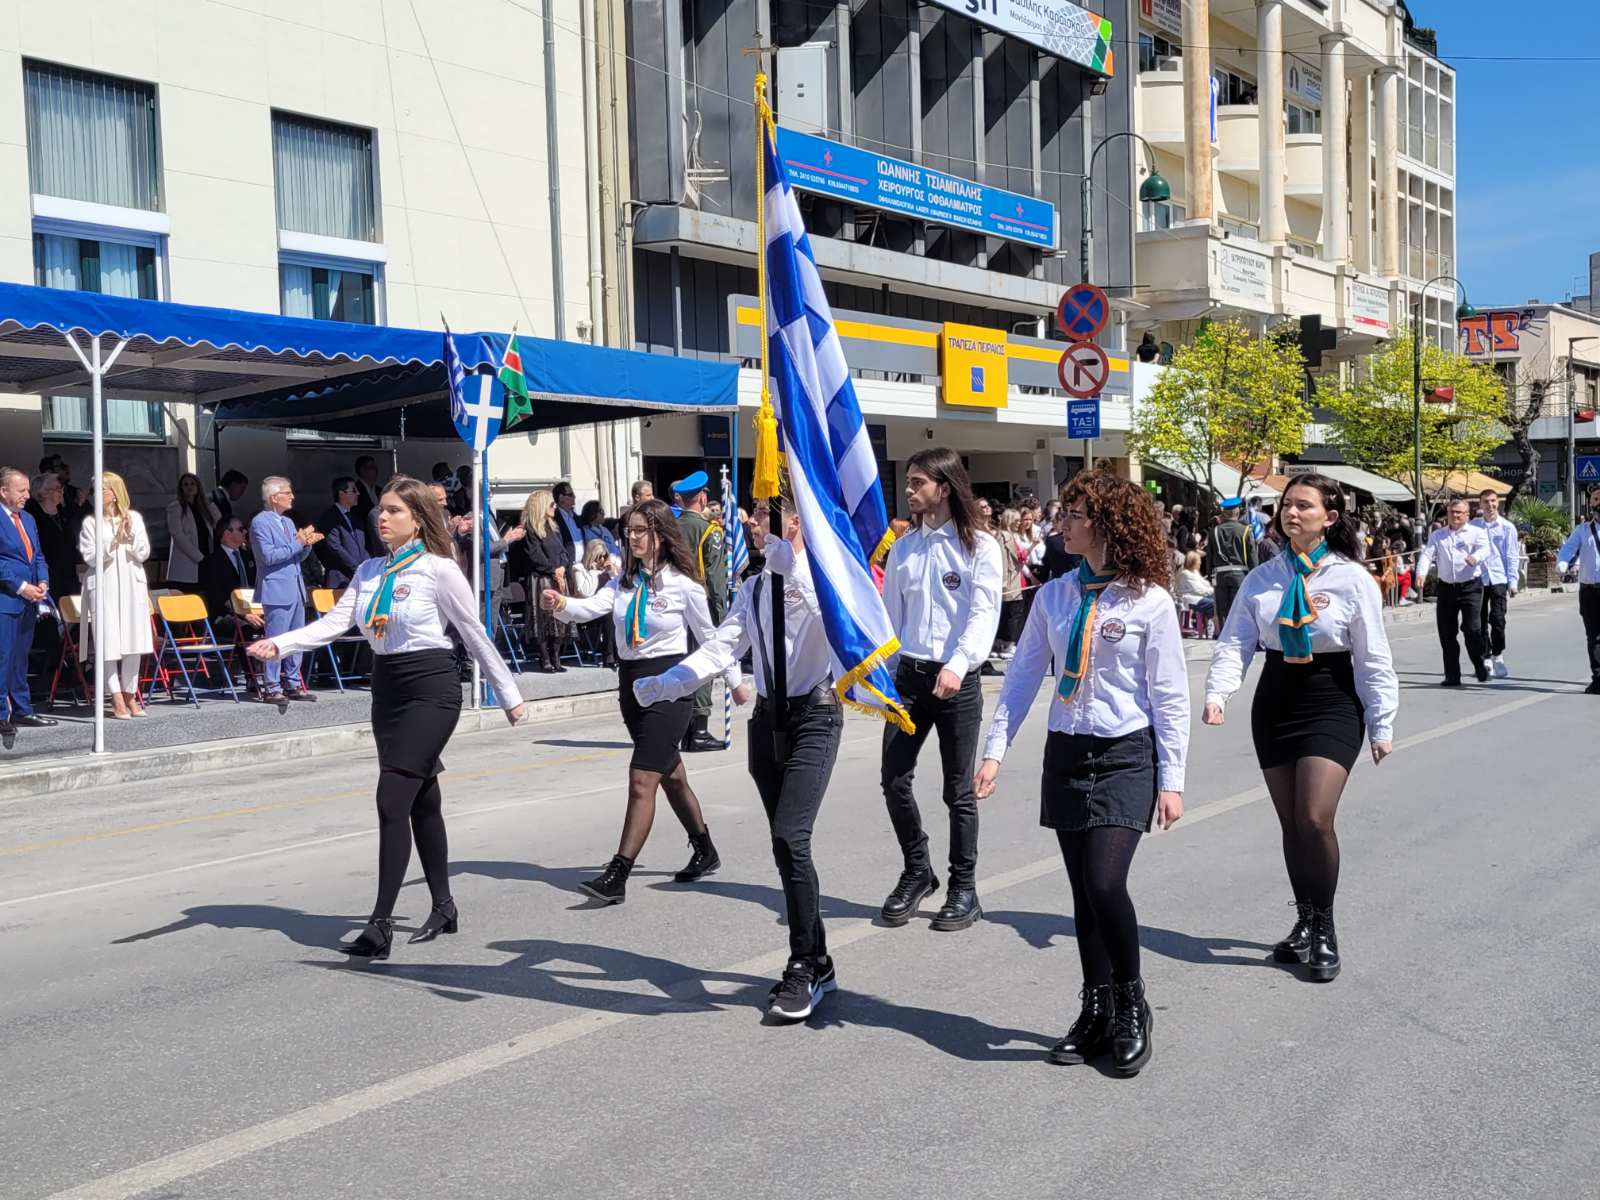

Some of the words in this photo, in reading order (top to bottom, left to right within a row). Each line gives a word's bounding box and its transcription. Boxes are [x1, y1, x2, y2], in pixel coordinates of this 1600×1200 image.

[877, 159, 921, 185] ΙΩΑΝΝΗΣ
[925, 173, 983, 201] ΤΣΙΑΜΠΑΛΗΣ
[878, 179, 925, 202] ΧΕΙΡΟΥΡΓΟΣ
[928, 193, 983, 216] ΟΦΘΑΛΜΙΑΤΡΟΣ
[949, 337, 977, 352] ΤΡΑΠΕΖΑ
[977, 341, 1005, 355] ΠΕΙΡΑΙΩΣ
[1071, 416, 1096, 427] ΤΑΞΙ
